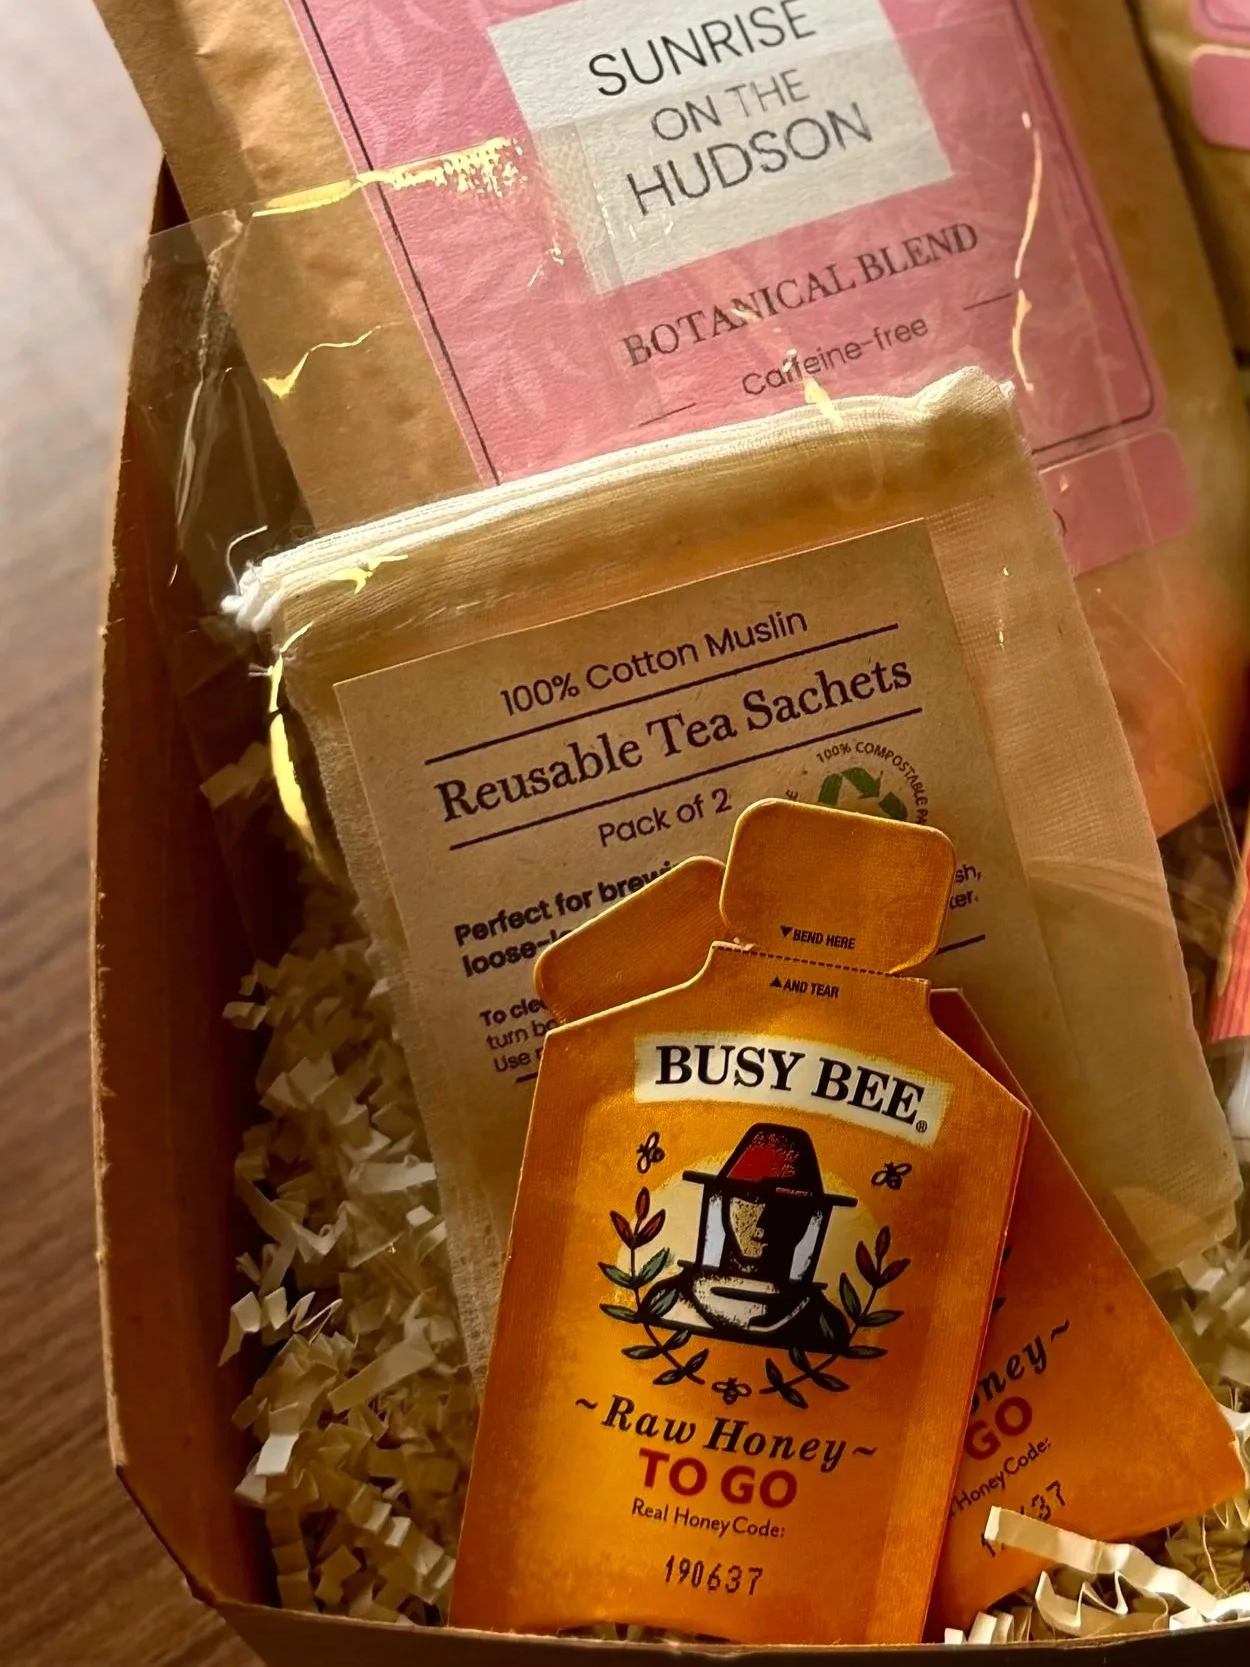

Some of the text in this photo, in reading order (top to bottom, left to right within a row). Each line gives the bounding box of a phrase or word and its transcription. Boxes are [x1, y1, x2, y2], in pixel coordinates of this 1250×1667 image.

[651, 69, 811, 142] ON THE
[626, 101, 874, 217] HUDSON
[622, 221, 979, 366] BOTANICAL BLEND
[741, 314, 929, 397] Caffeine-free
[500, 608, 809, 717] 100% Cotton Muslin
[434, 656, 913, 822] Reusable Tea Sachets
[816, 742, 851, 764] 100%
[855, 741, 929, 806] COMPOSTABLE
[597, 786, 733, 849] Pack of 2
[454, 901, 553, 946] Perfect
[554, 888, 593, 917] for
[792, 928, 856, 950] BEND HERE
[480, 1009, 507, 1027] To
[783, 979, 839, 999] AND TEAR
[486, 1028, 530, 1050] turn
[493, 1051, 532, 1073] Use
[654, 1043, 806, 1093] BUSY
[963, 1395, 1033, 1461] GO
[638, 1447, 799, 1509] TO GO
[954, 1469, 1006, 1513] Honey
[1003, 1437, 1052, 1476] Code:
[631, 1500, 787, 1540] Real Honey Code:
[663, 1552, 765, 1596] 190637
